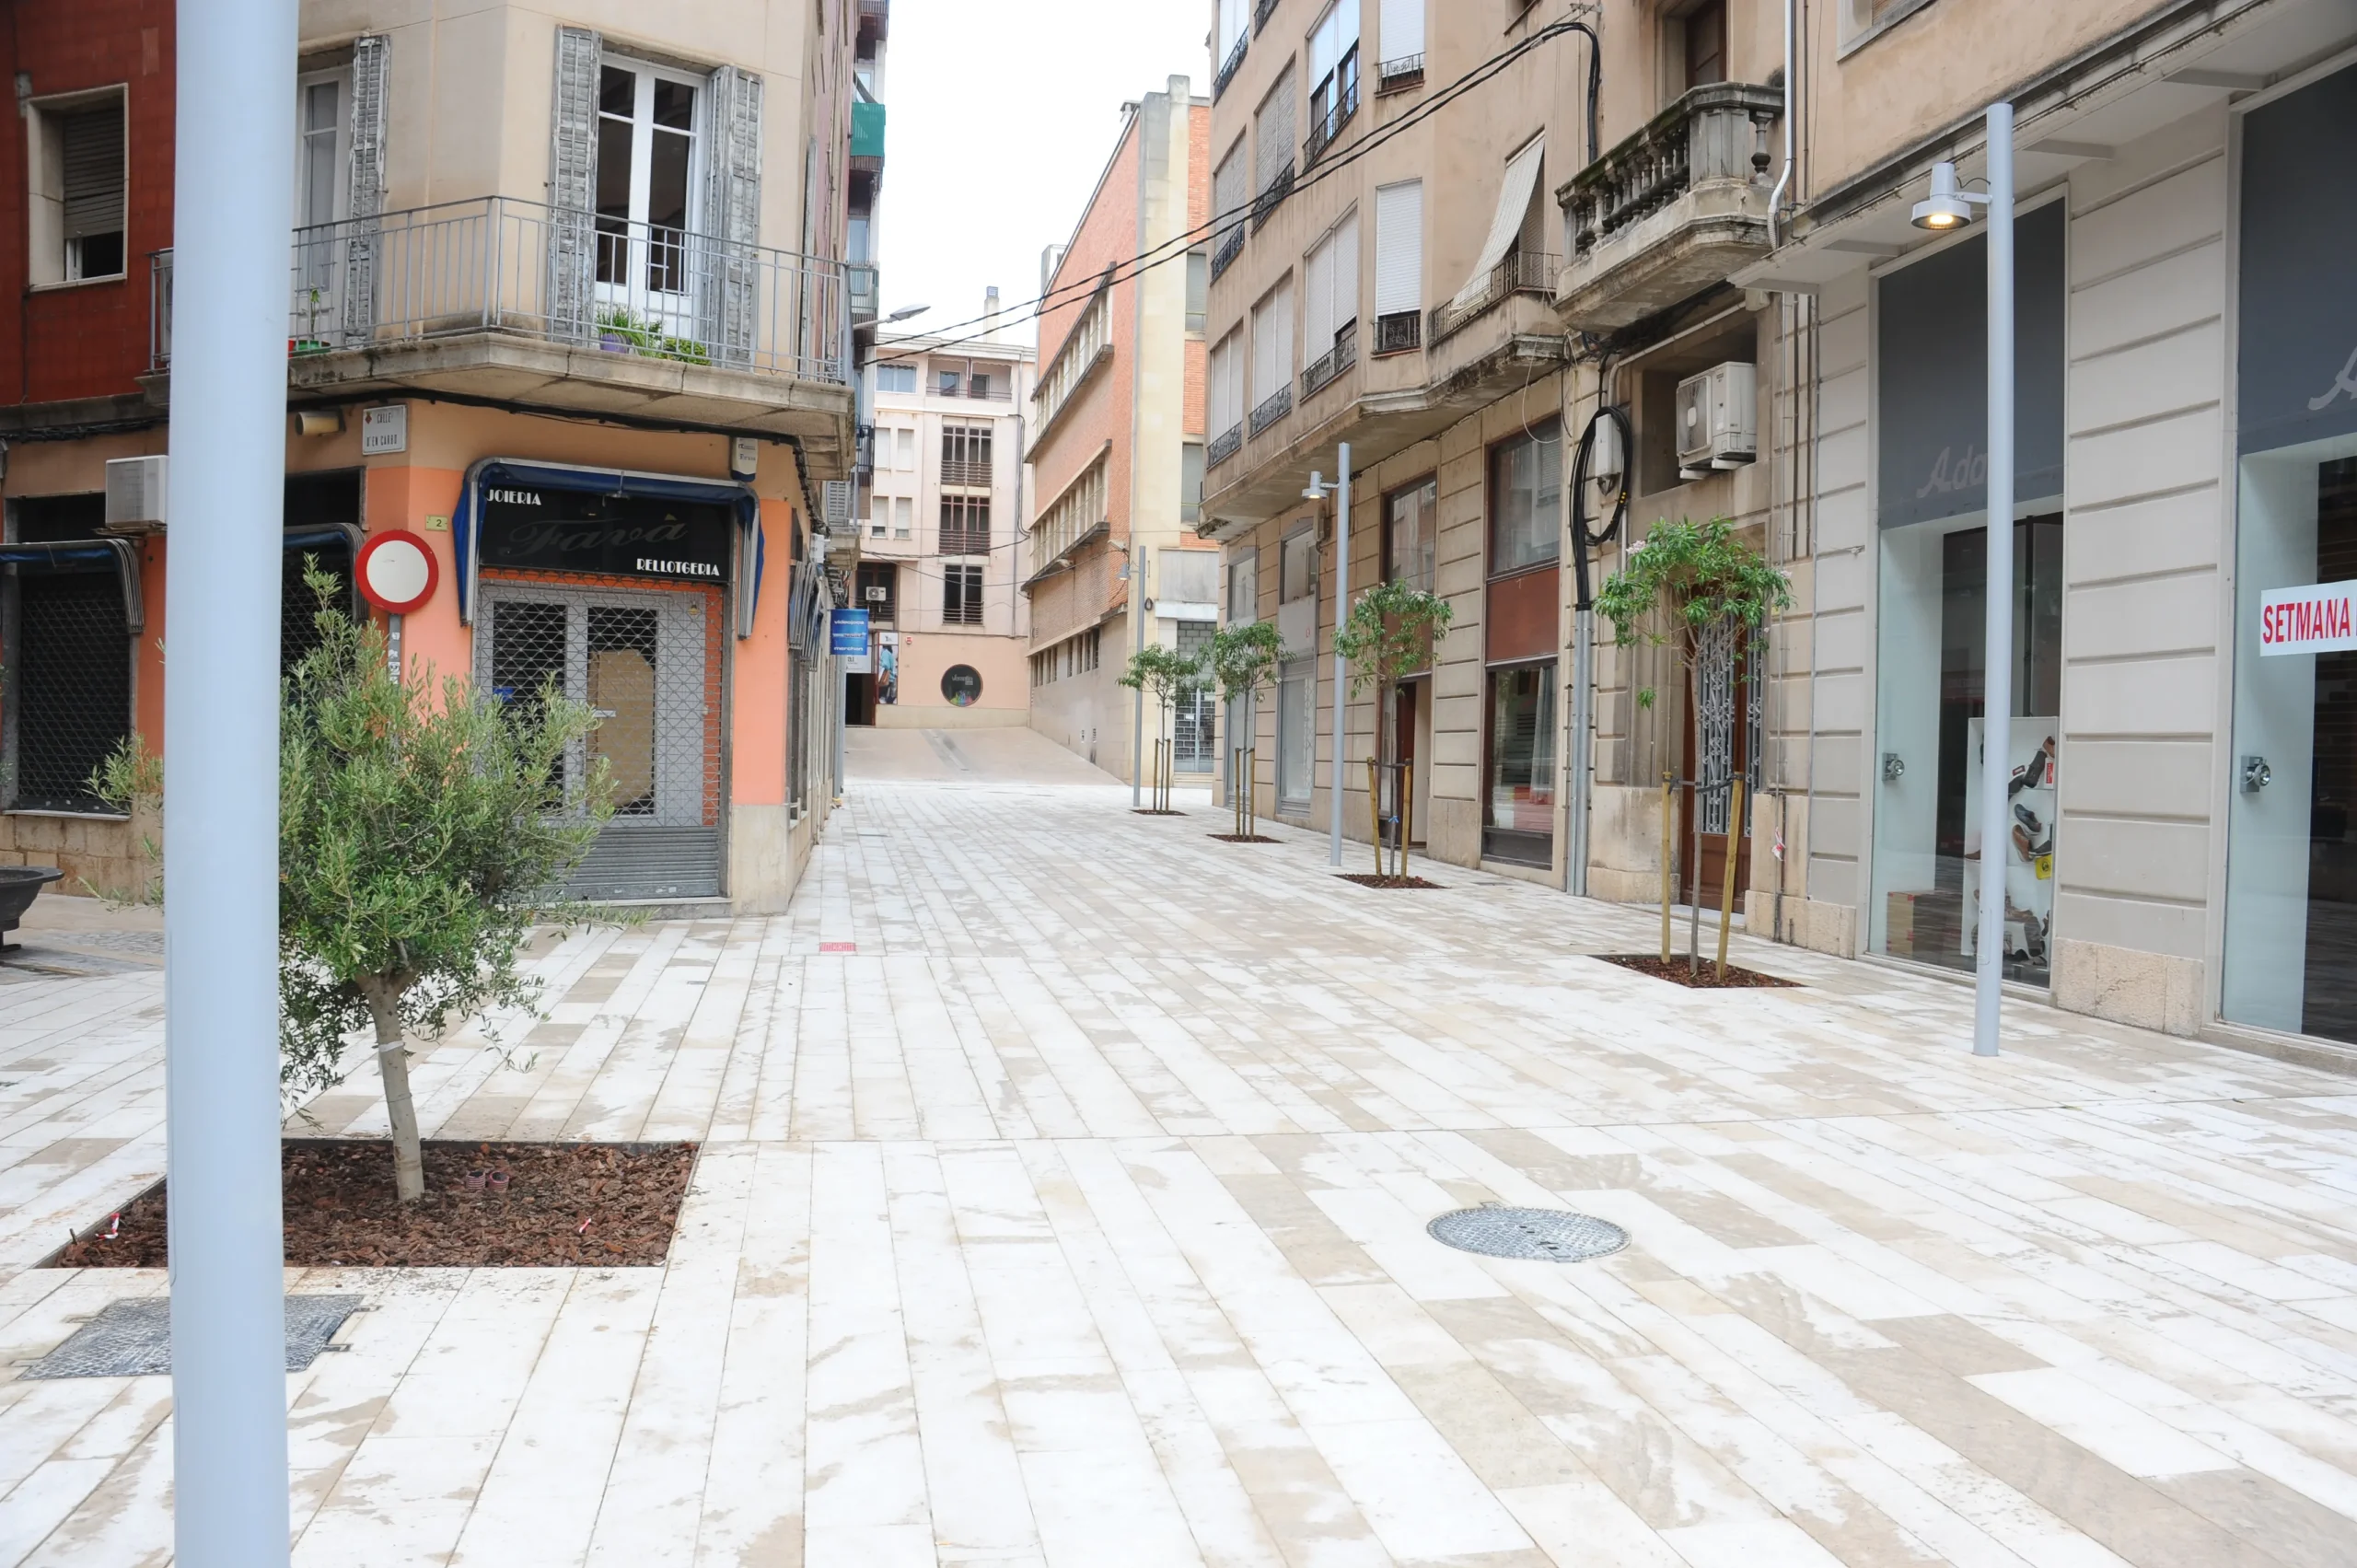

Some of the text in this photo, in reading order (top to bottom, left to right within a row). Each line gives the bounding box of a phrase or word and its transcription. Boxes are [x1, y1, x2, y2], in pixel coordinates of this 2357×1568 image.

[486, 489, 541, 505] JOIERIA
[435, 518, 443, 528] 2
[636, 558, 720, 576] RELLOTGERIA
[2262, 597, 2351, 645] SETMANA
